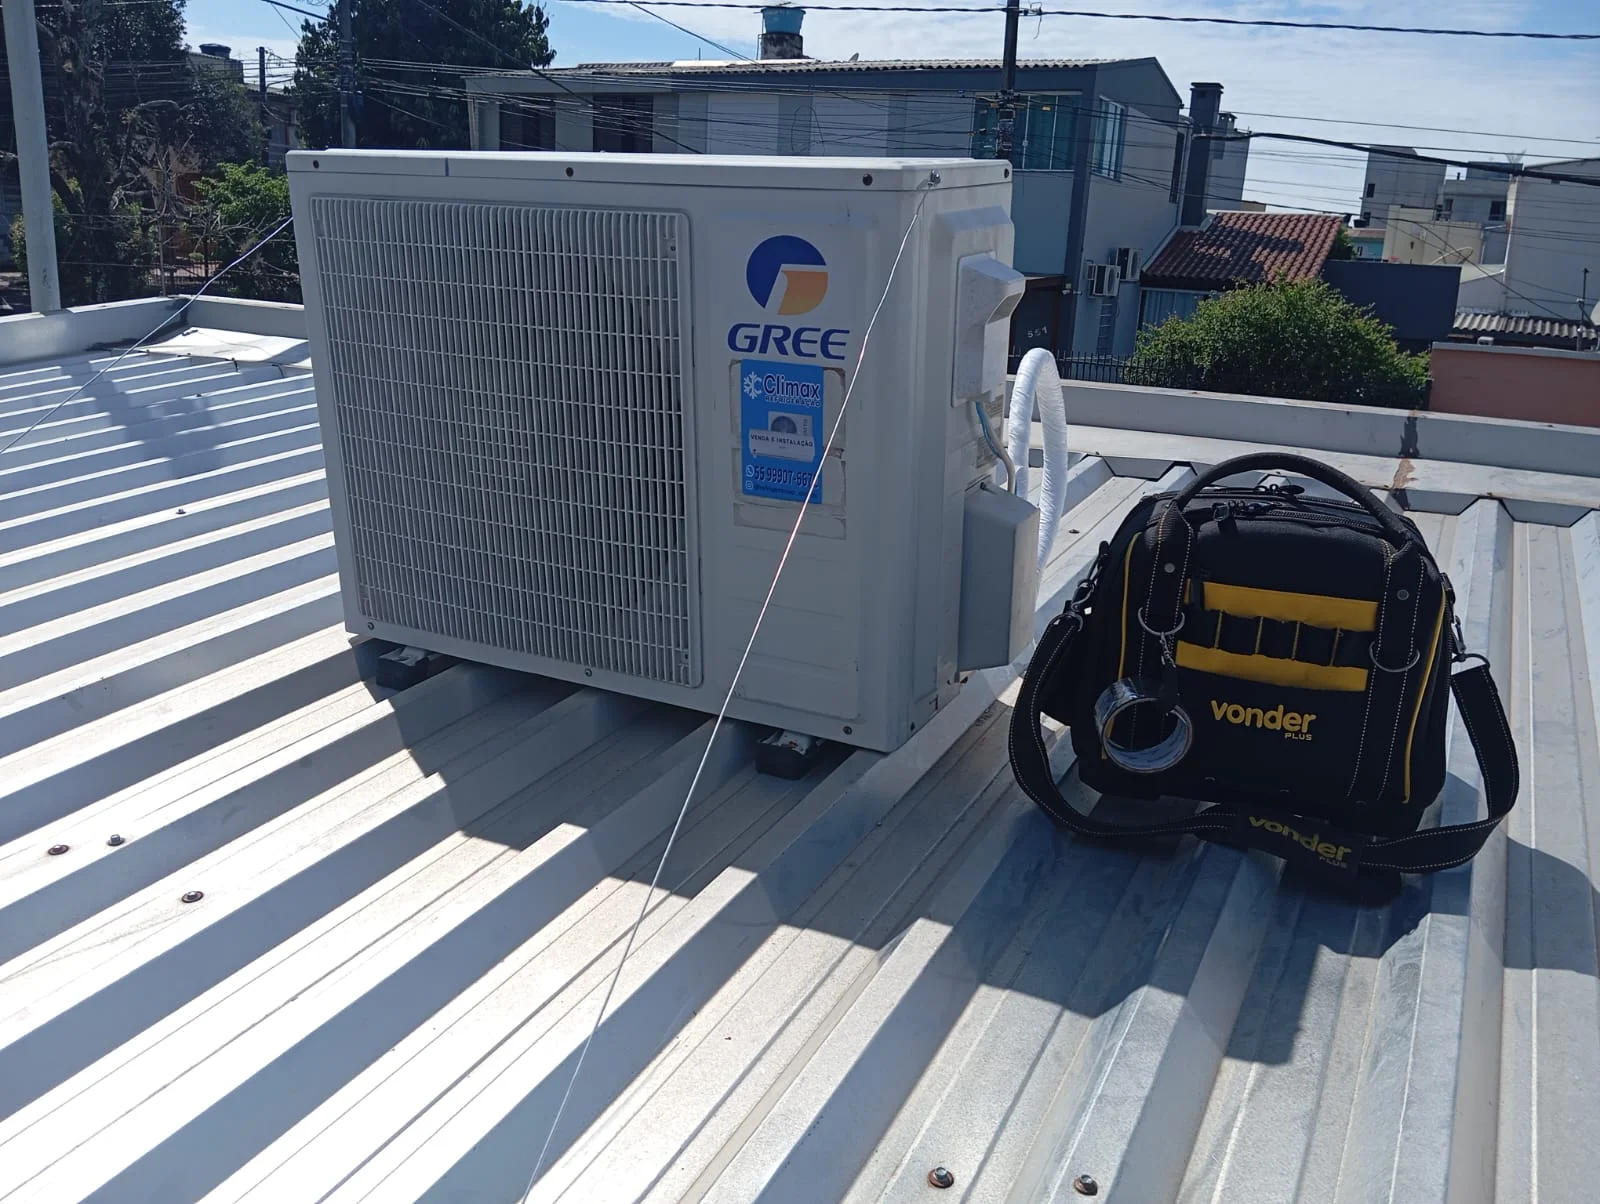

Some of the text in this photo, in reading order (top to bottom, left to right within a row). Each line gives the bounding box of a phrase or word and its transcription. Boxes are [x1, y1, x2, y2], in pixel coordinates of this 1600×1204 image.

[727, 322, 850, 360] GREE
[763, 373, 821, 400] Climax
[750, 433, 769, 442] VENDA
[776, 437, 814, 447] INSTALAÇÃO
[754, 465, 765, 482] 55
[1210, 699, 1317, 734] vonder
[1284, 732, 1313, 741] PLUS
[1247, 815, 1352, 861] vonder
[1319, 856, 1348, 870] PLUS
